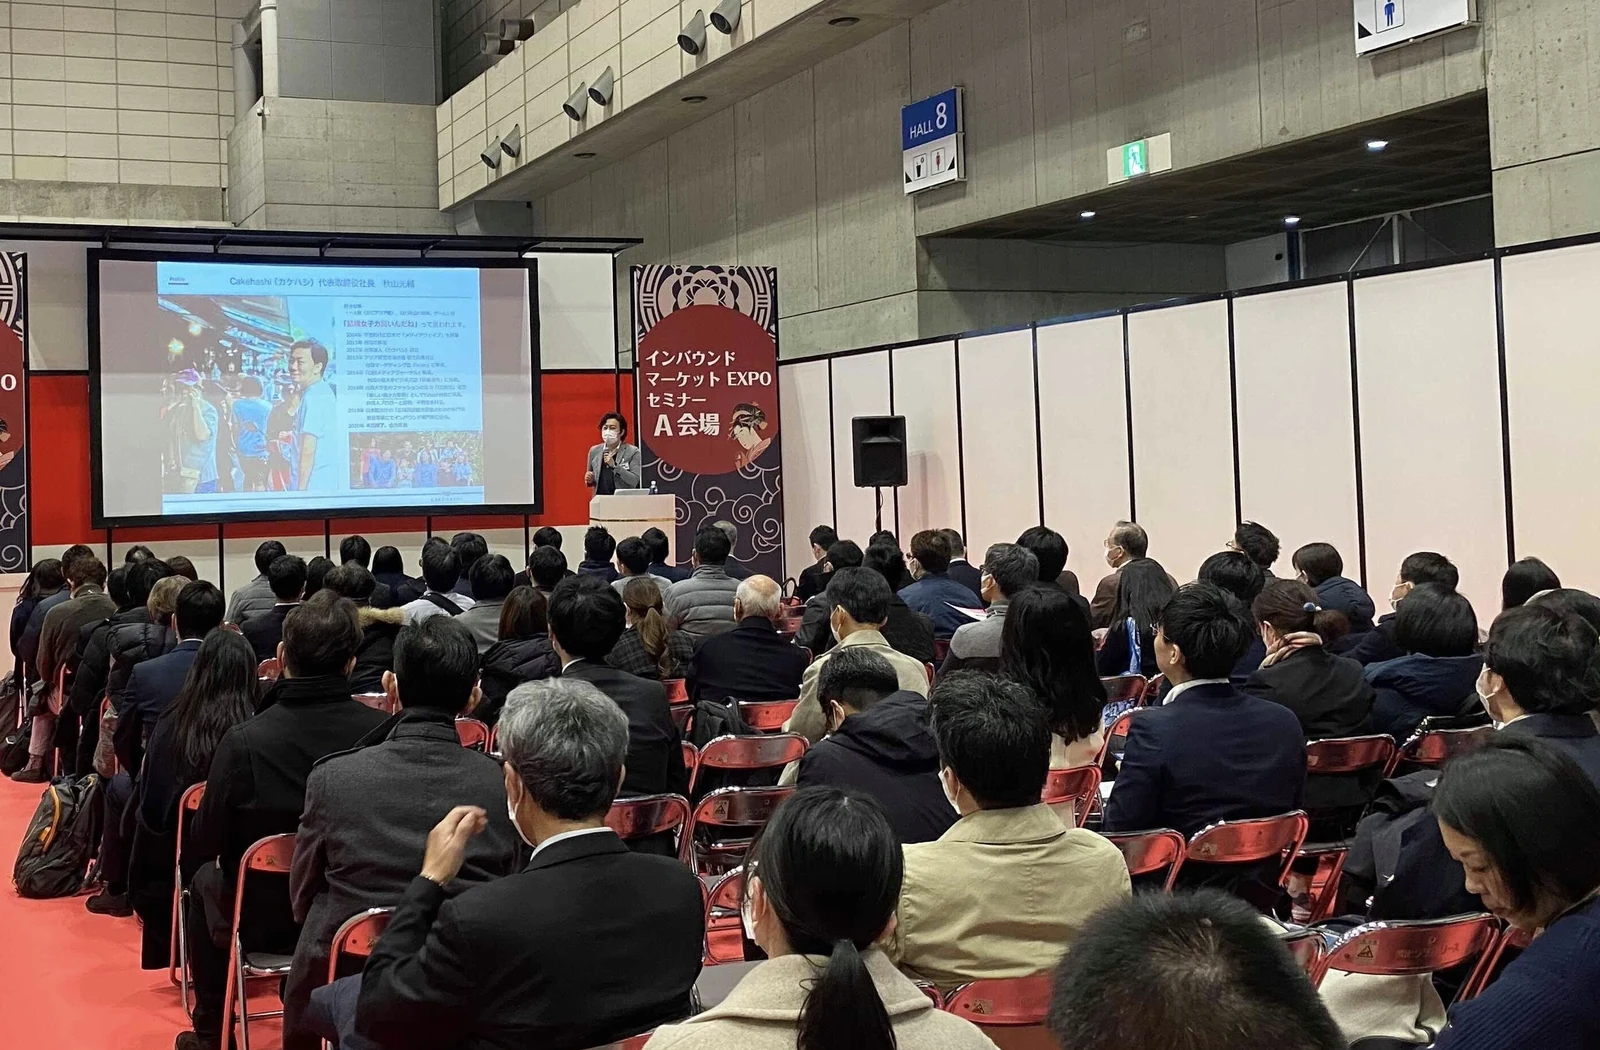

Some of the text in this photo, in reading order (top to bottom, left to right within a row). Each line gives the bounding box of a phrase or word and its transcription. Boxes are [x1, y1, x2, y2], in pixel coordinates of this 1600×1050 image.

[909, 101, 948, 140] HALL 8
[229, 277, 272, 286] Cakehashi
[645, 350, 736, 367] インバウンド
[645, 371, 772, 388] マーケット EXPO
[646, 392, 707, 408] セミナー
[653, 412, 721, 437] A 会場
